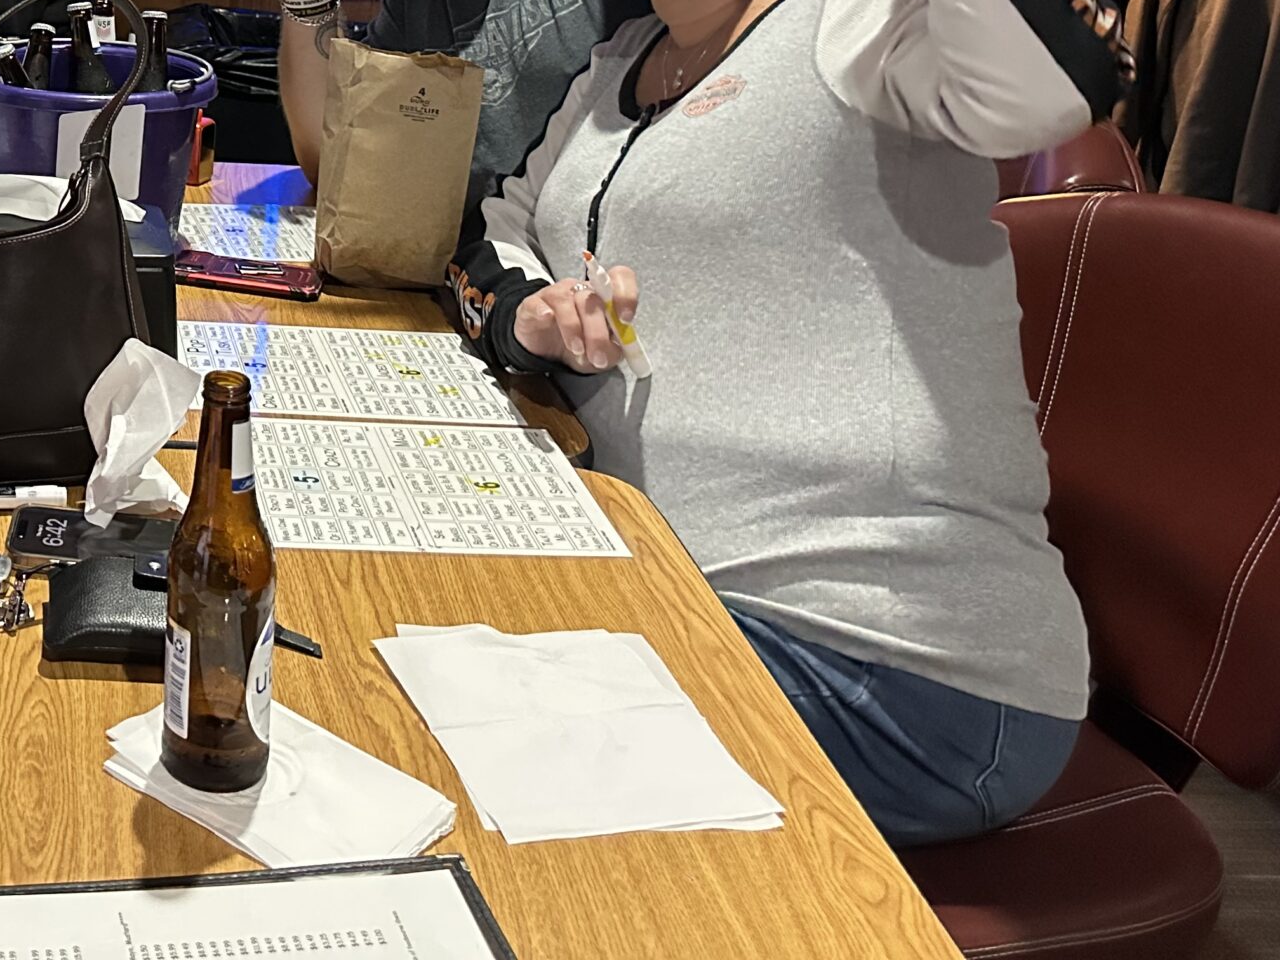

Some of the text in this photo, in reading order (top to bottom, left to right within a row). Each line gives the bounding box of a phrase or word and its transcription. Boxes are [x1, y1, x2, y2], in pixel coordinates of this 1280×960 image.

[418, 87, 425, 96] 4
[386, 428, 411, 447] MAGIC
[318, 447, 342, 467] CRAZY
[292, 475, 320, 483] 5
[471, 481, 502, 489] 6
[41, 518, 68, 547] 6:42
